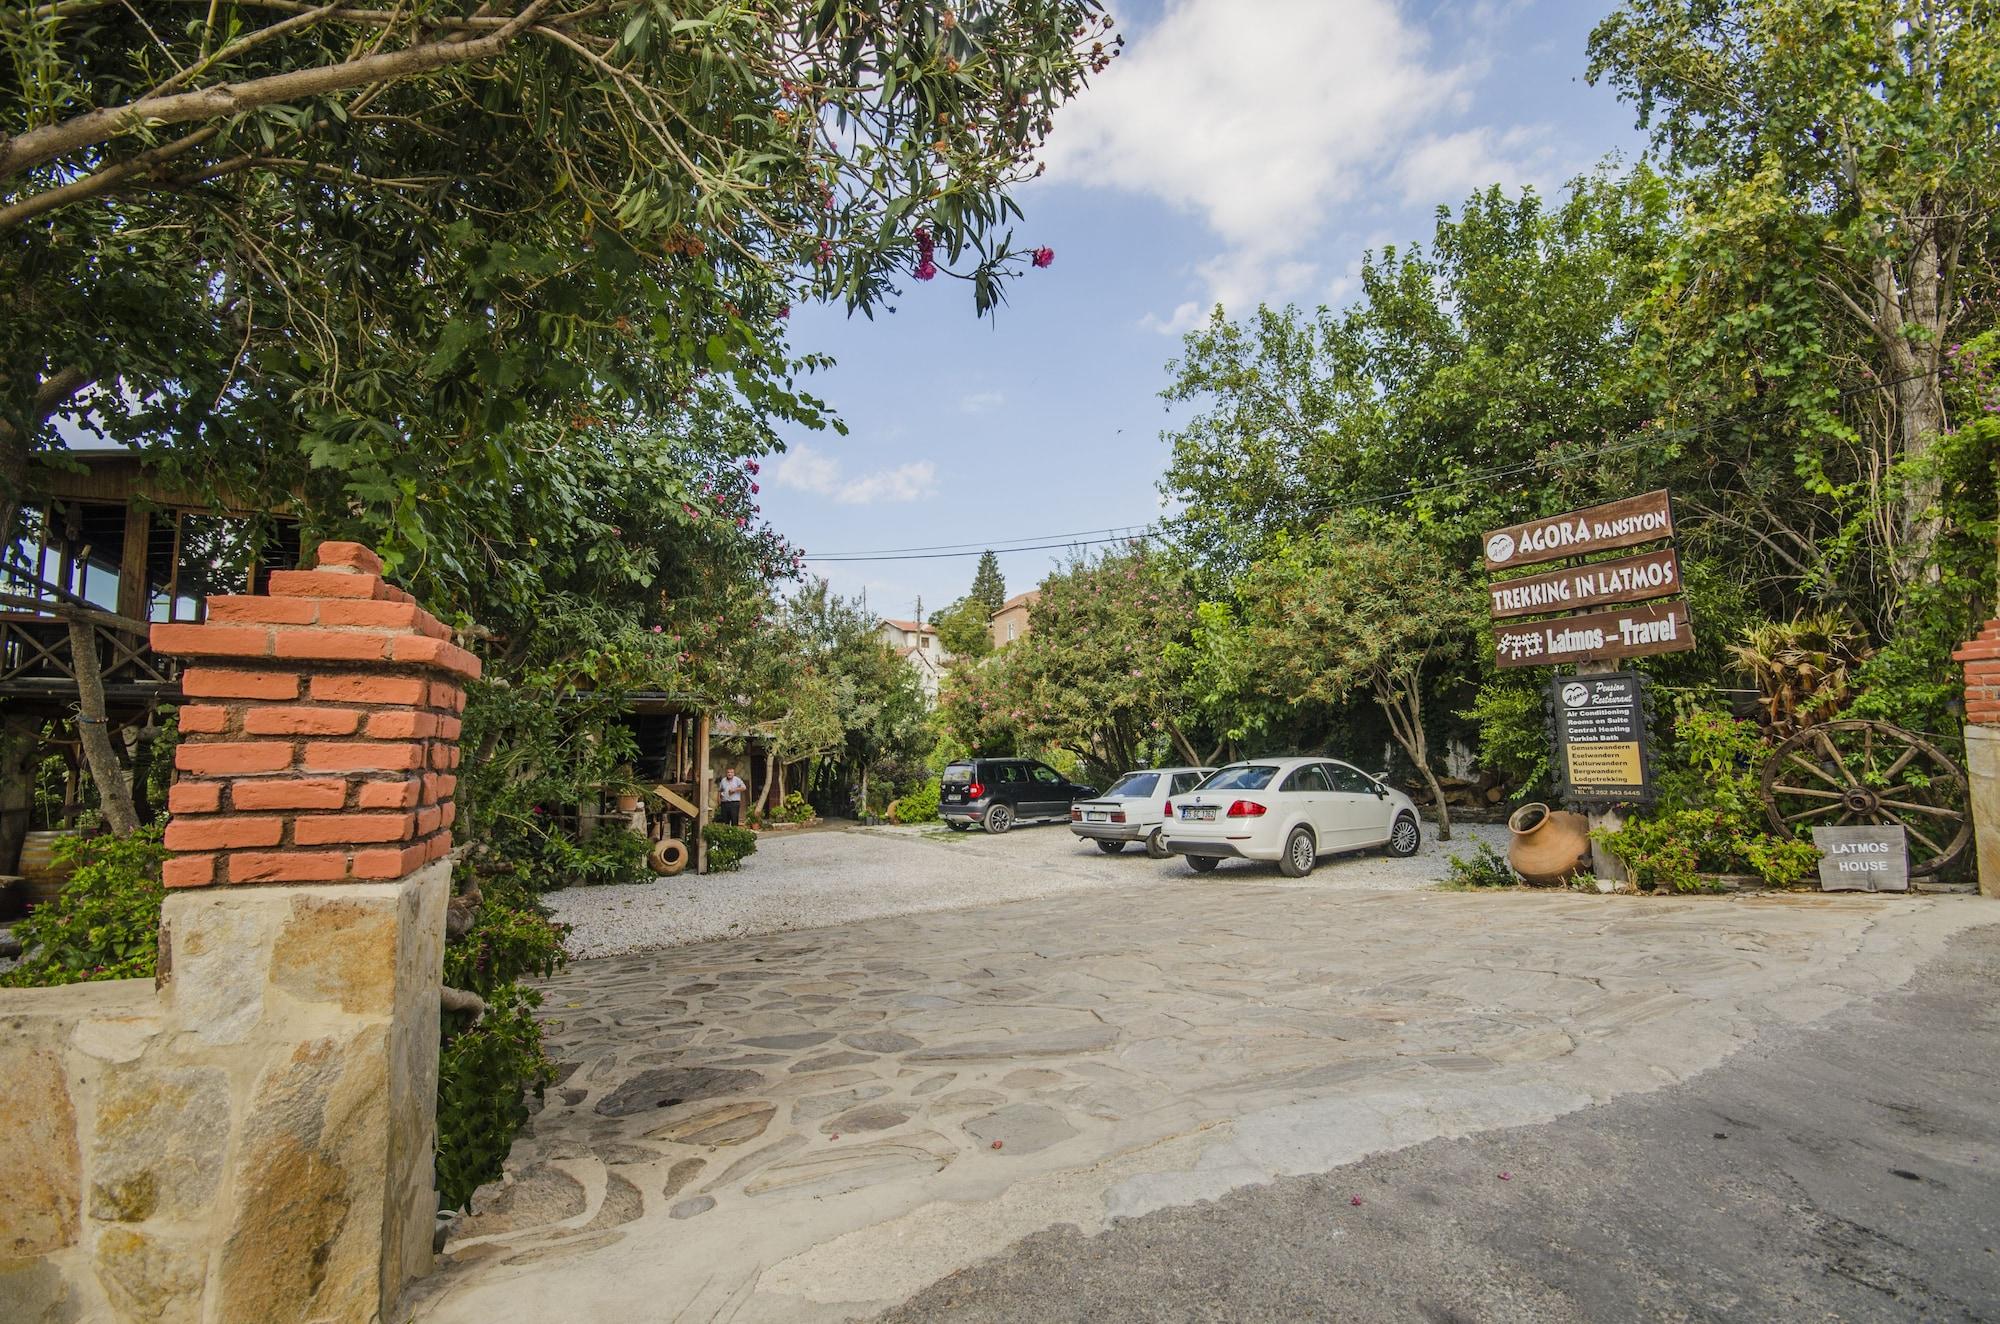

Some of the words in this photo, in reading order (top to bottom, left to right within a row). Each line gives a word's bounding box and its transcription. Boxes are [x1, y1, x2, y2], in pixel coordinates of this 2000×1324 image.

[1518, 518, 1591, 554] AGORA
[1594, 510, 1667, 540] PANSIYON
[1492, 578, 1570, 611] TREKKING
[1575, 575, 1596, 598] IN
[1598, 560, 1674, 594] LATMOS
[1546, 628, 1604, 654] Latmos
[1619, 612, 1677, 646] Travel
[1595, 682, 1625, 693] Pension
[1566, 691, 1587, 703] Agora
[1591, 694, 1633, 705] Restaurant
[1579, 708, 1630, 717] Conditioning
[1598, 725, 1631, 733] Heating
[1831, 842, 1889, 854] LATMOS
[1838, 861, 1889, 872] HOUSE
